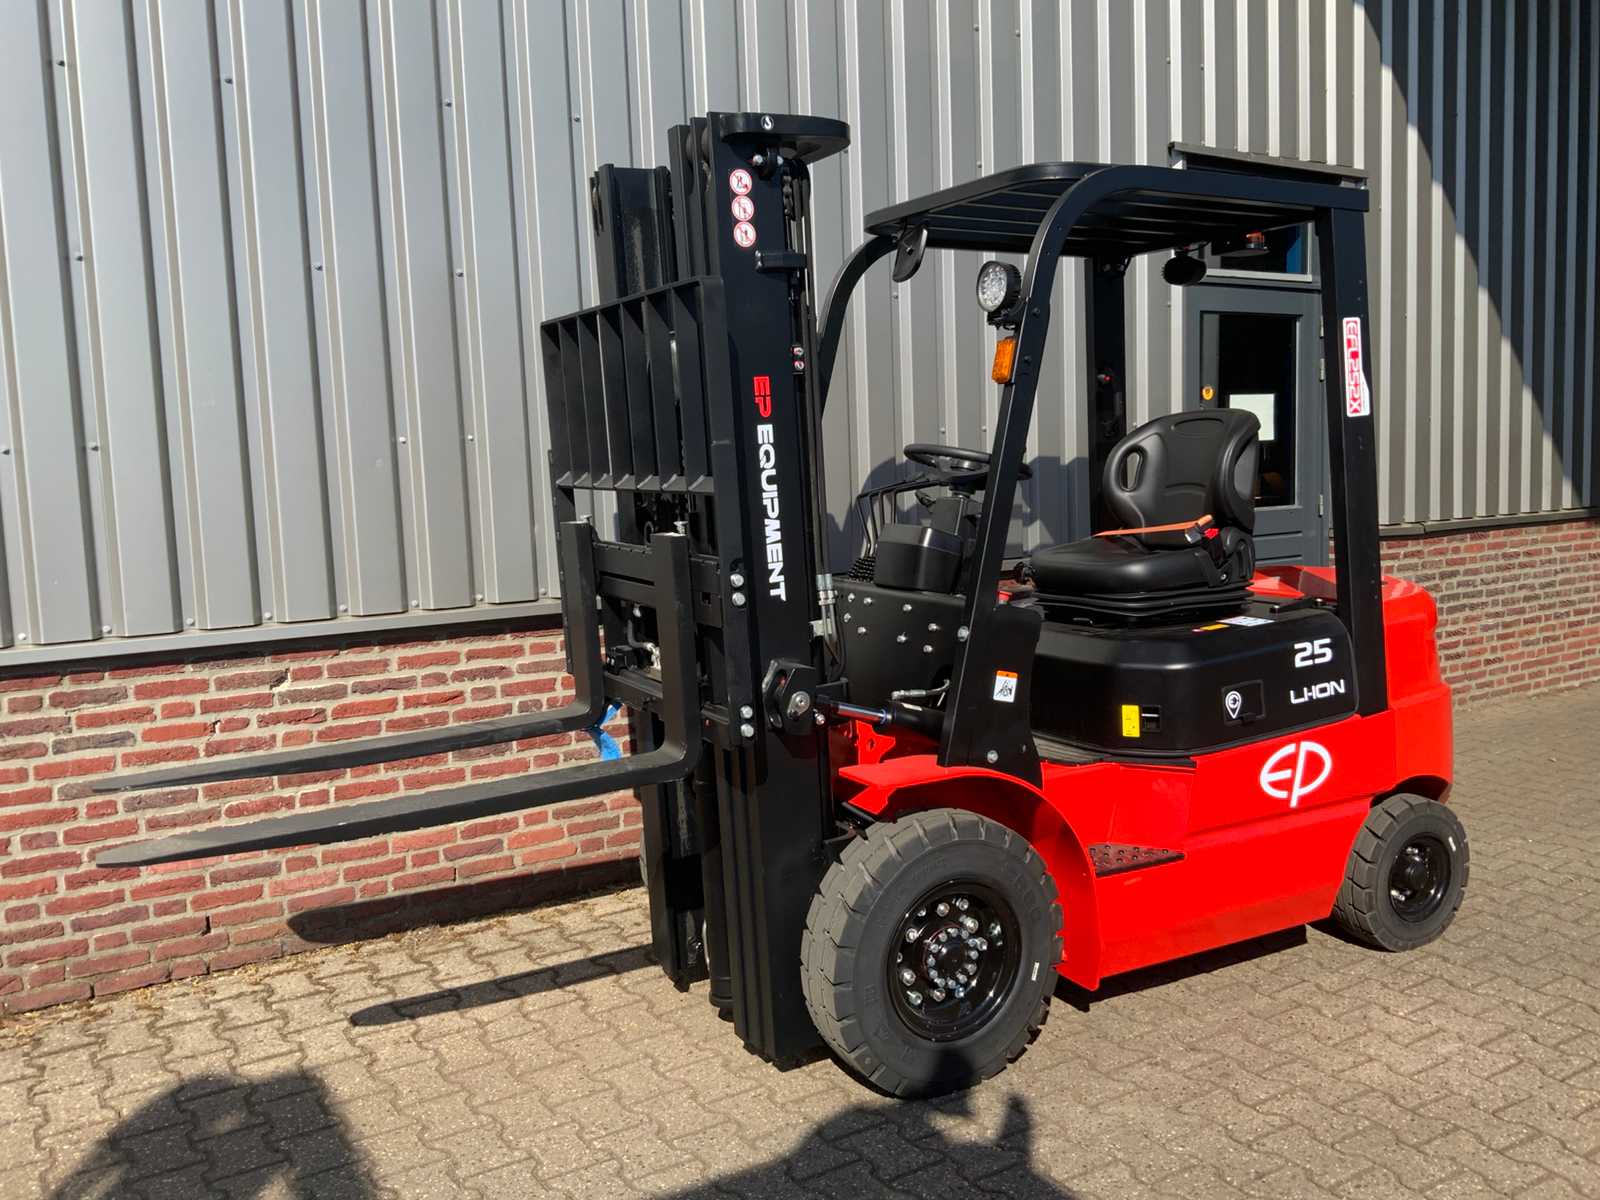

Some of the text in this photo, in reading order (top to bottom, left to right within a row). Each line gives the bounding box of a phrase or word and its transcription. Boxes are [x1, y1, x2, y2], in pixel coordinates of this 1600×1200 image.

[1346, 321, 1362, 413] EFL252X
[753, 376, 786, 602] EP EQUIPMENT
[1294, 638, 1333, 668] 25
[1259, 740, 1333, 808] EP
